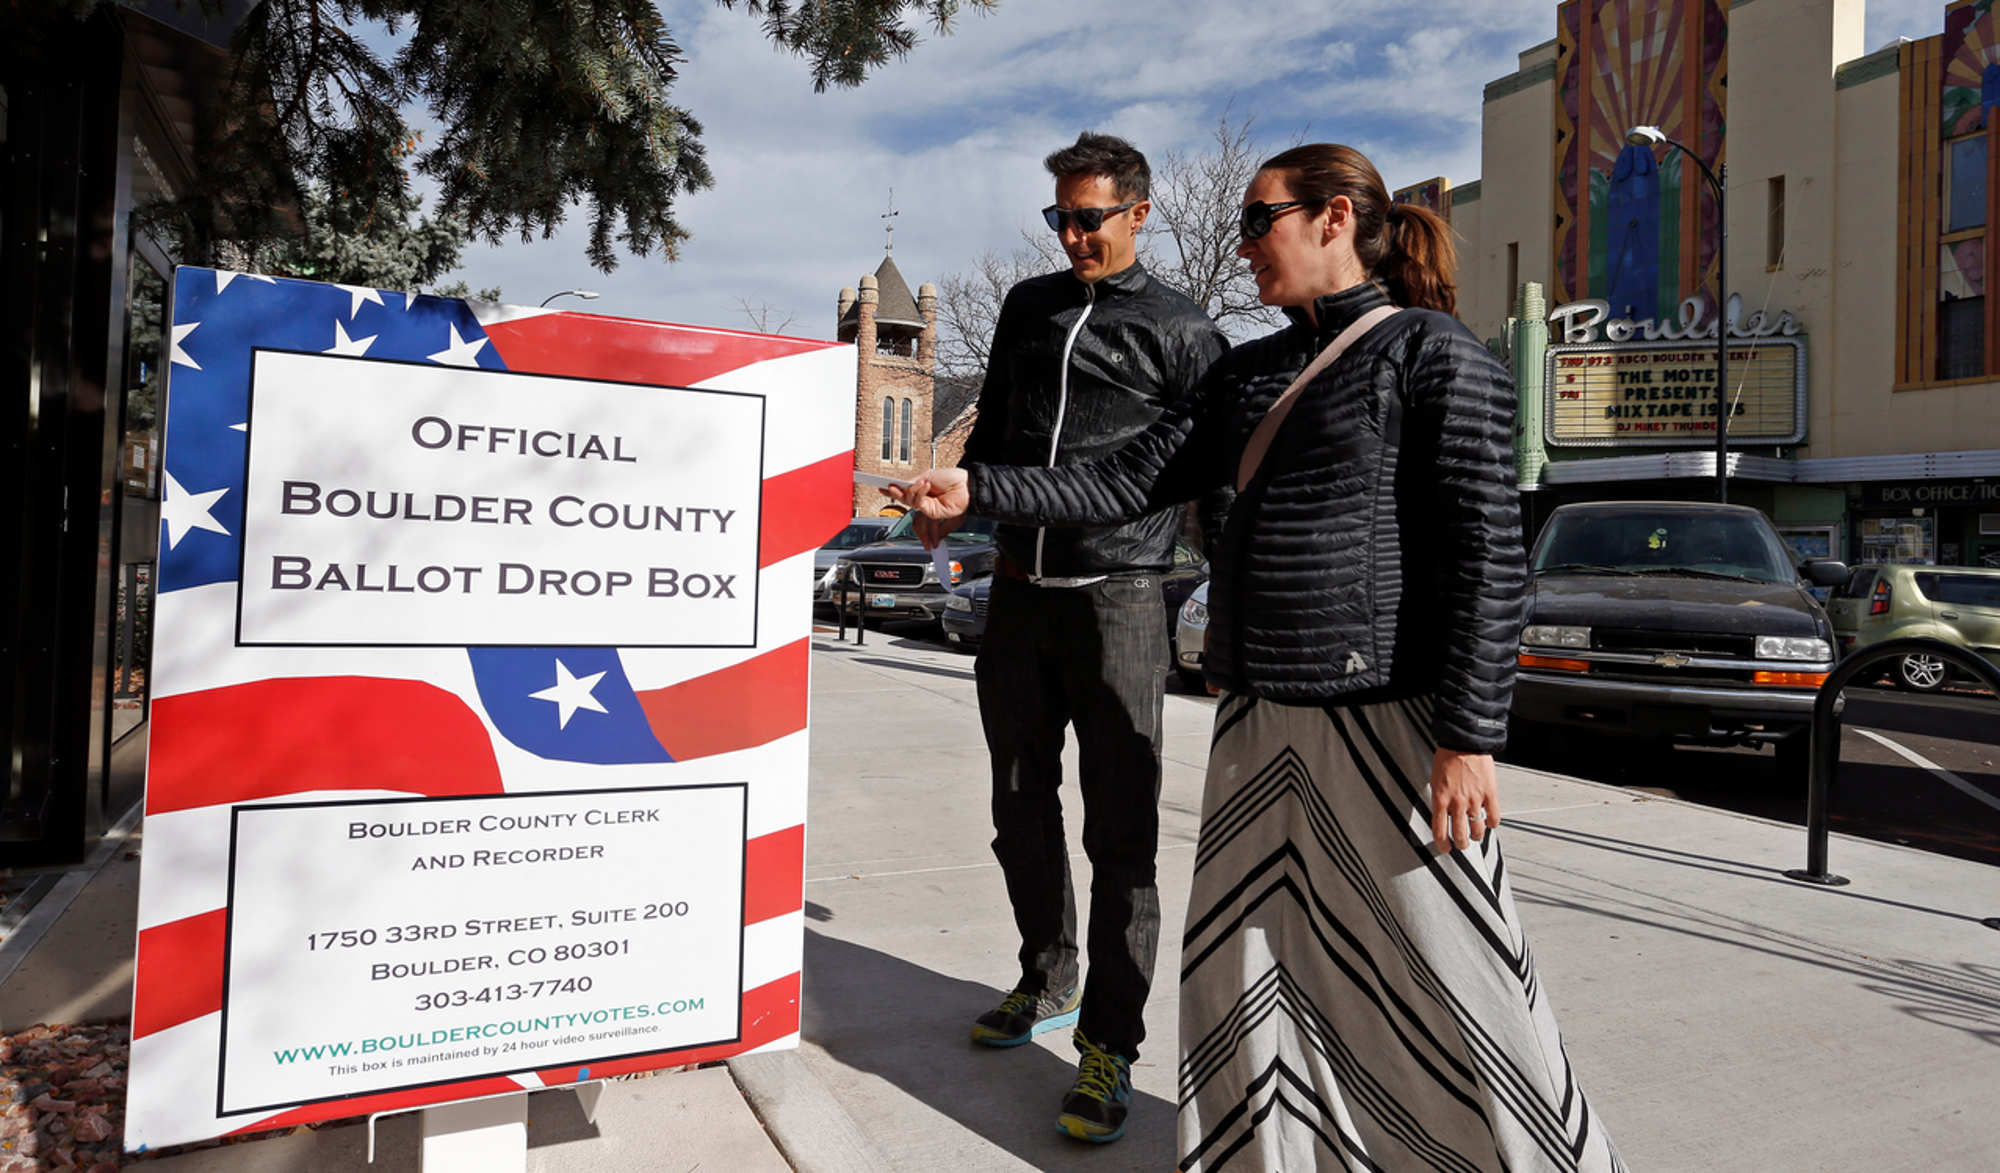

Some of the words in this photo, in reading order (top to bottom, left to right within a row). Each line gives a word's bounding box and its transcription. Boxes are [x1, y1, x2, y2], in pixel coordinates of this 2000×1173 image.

[1550, 292, 1801, 344] Boulder
[1618, 355, 1648, 364] KBCO
[1653, 353, 1704, 362] BOULDER
[1712, 351, 1759, 361] WEKLY
[1618, 370, 1653, 384] THE
[1663, 369, 1728, 382] MOTE
[1625, 386, 1721, 401] PRESENTS
[1606, 403, 1692, 418] MIXTAPE
[1617, 423, 1631, 432] DJ
[1635, 423, 1668, 432] MIKEY
[1673, 421, 1719, 431] THUNDE
[412, 416, 637, 463] OFFICIAL
[281, 480, 533, 526] BOULDER
[548, 495, 736, 534] COUNTY
[1882, 487, 1912, 502] BOX
[271, 555, 483, 595] BALLOT
[497, 562, 633, 597] DROP
[647, 567, 737, 600] BOX
[873, 570, 900, 579] GMC
[348, 819, 471, 840] BOULDER
[479, 813, 577, 832] COUNTY
[584, 808, 660, 826] CLERK
[411, 853, 465, 872] AND
[473, 844, 605, 868] RECORDER
[307, 928, 377, 952] 1750
[385, 924, 457, 944] 33RD
[464, 914, 563, 937] STREET,
[571, 907, 637, 927] SUITE
[643, 901, 689, 920] 200
[371, 954, 499, 981] BOULDER,
[507, 948, 547, 966] CO
[553, 939, 629, 962] 80301
[414, 976, 593, 1012] 303-413-7740
[274, 997, 705, 1065] WWW.BOULDERCOUNTYVOTES.COM
[329, 1064, 358, 1077] This
[362, 1061, 387, 1074] box
[392, 1058, 403, 1068] is
[407, 1047, 480, 1066] maintained
[483, 1045, 499, 1057] by
[502, 1042, 518, 1053] 24
[520, 1038, 549, 1051] hour
[552, 1033, 586, 1047] video
[588, 1026, 662, 1043] surveillance.
